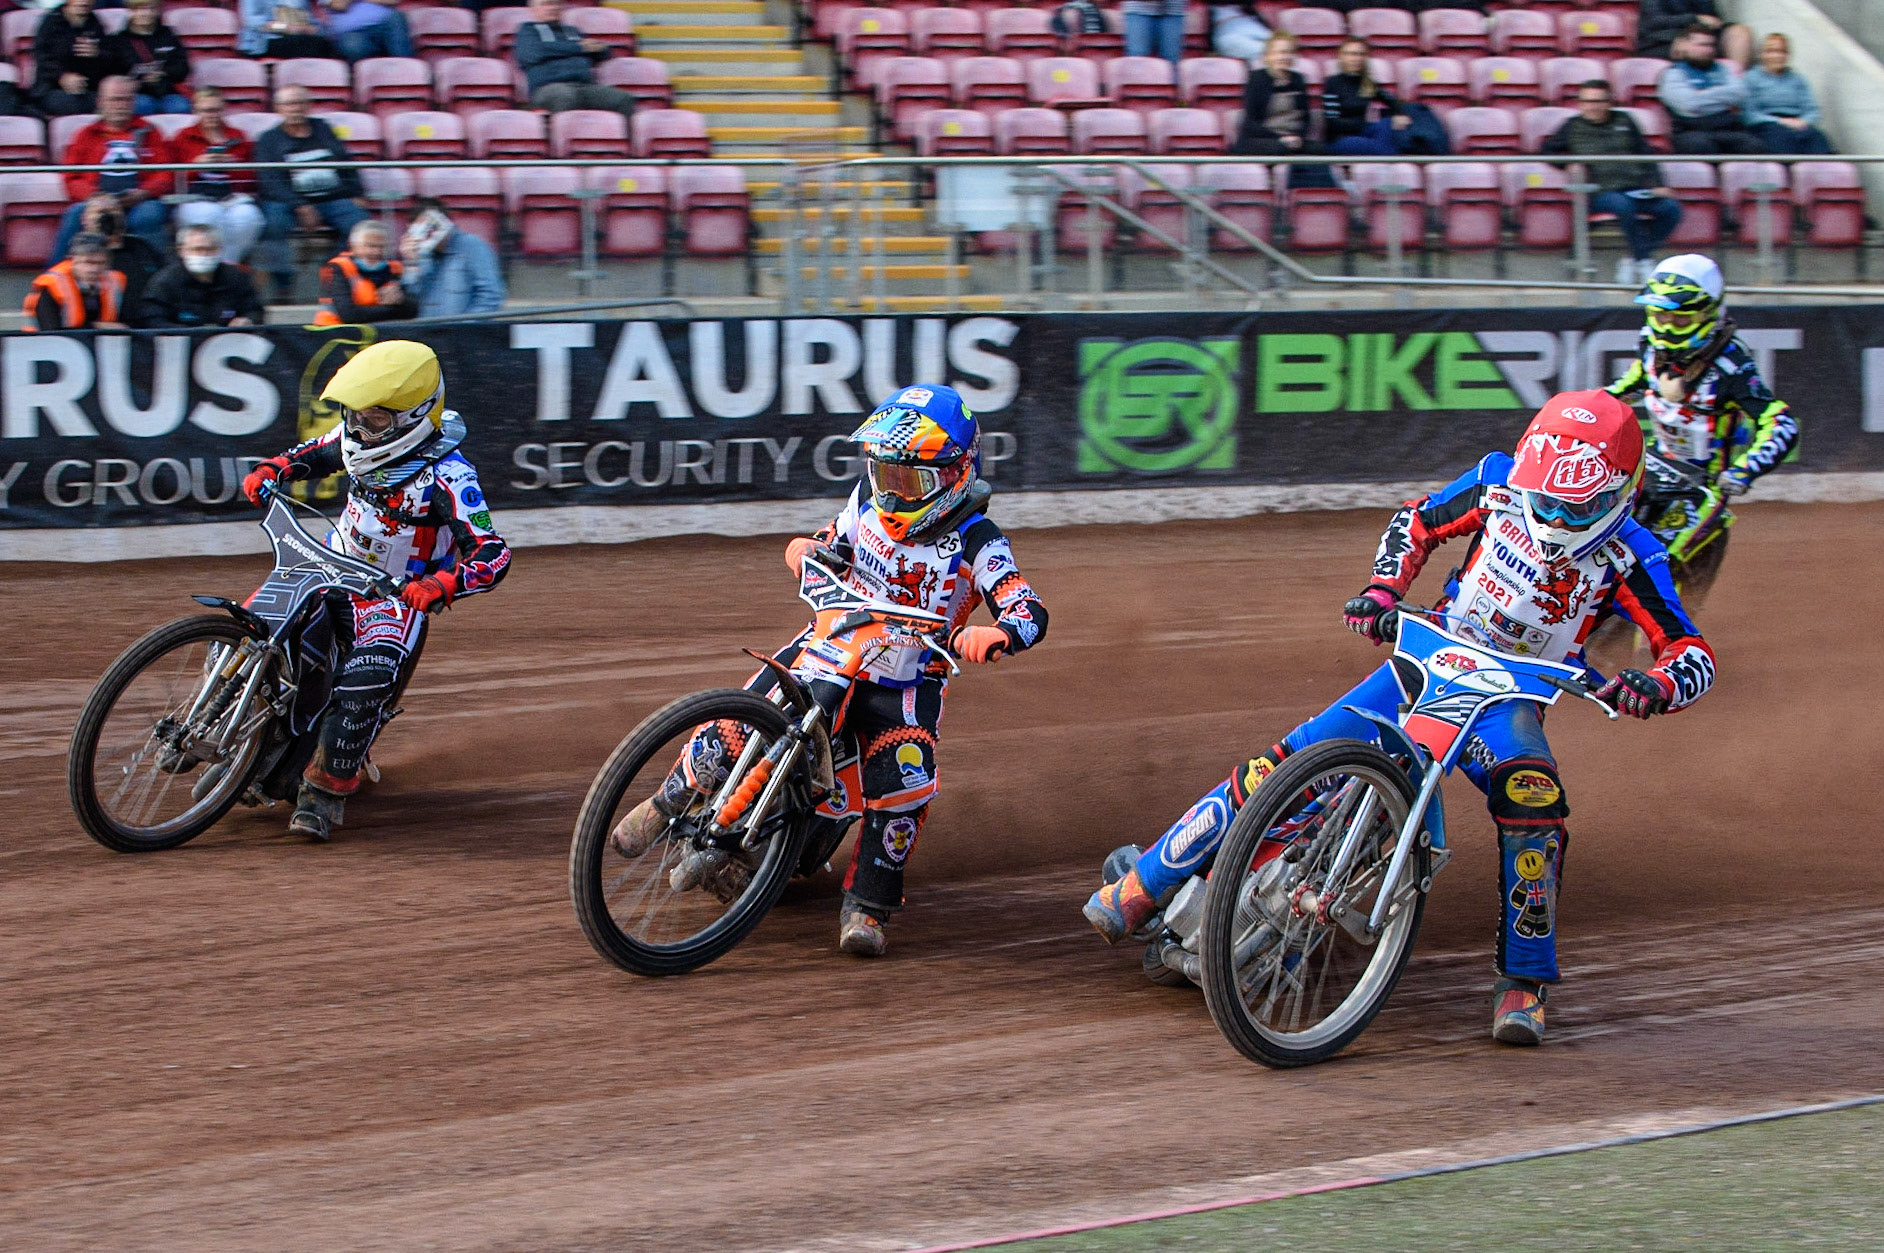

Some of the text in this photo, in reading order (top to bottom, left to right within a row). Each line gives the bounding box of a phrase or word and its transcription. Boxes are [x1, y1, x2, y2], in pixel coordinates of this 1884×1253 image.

[2, 333, 281, 438] RUS
[510, 317, 1022, 421] TAURUS
[420, 469, 433, 485] 16
[510, 436, 803, 491] SECURITY
[858, 543, 887, 578] OUTH
[938, 535, 960, 552] 25
[1492, 537, 1538, 583] YOUTH
[1498, 518, 1543, 565] BRITIS
[1477, 573, 1514, 608] 2021
[1482, 552, 1526, 598] Championship
[1170, 803, 1217, 862] HAGON
